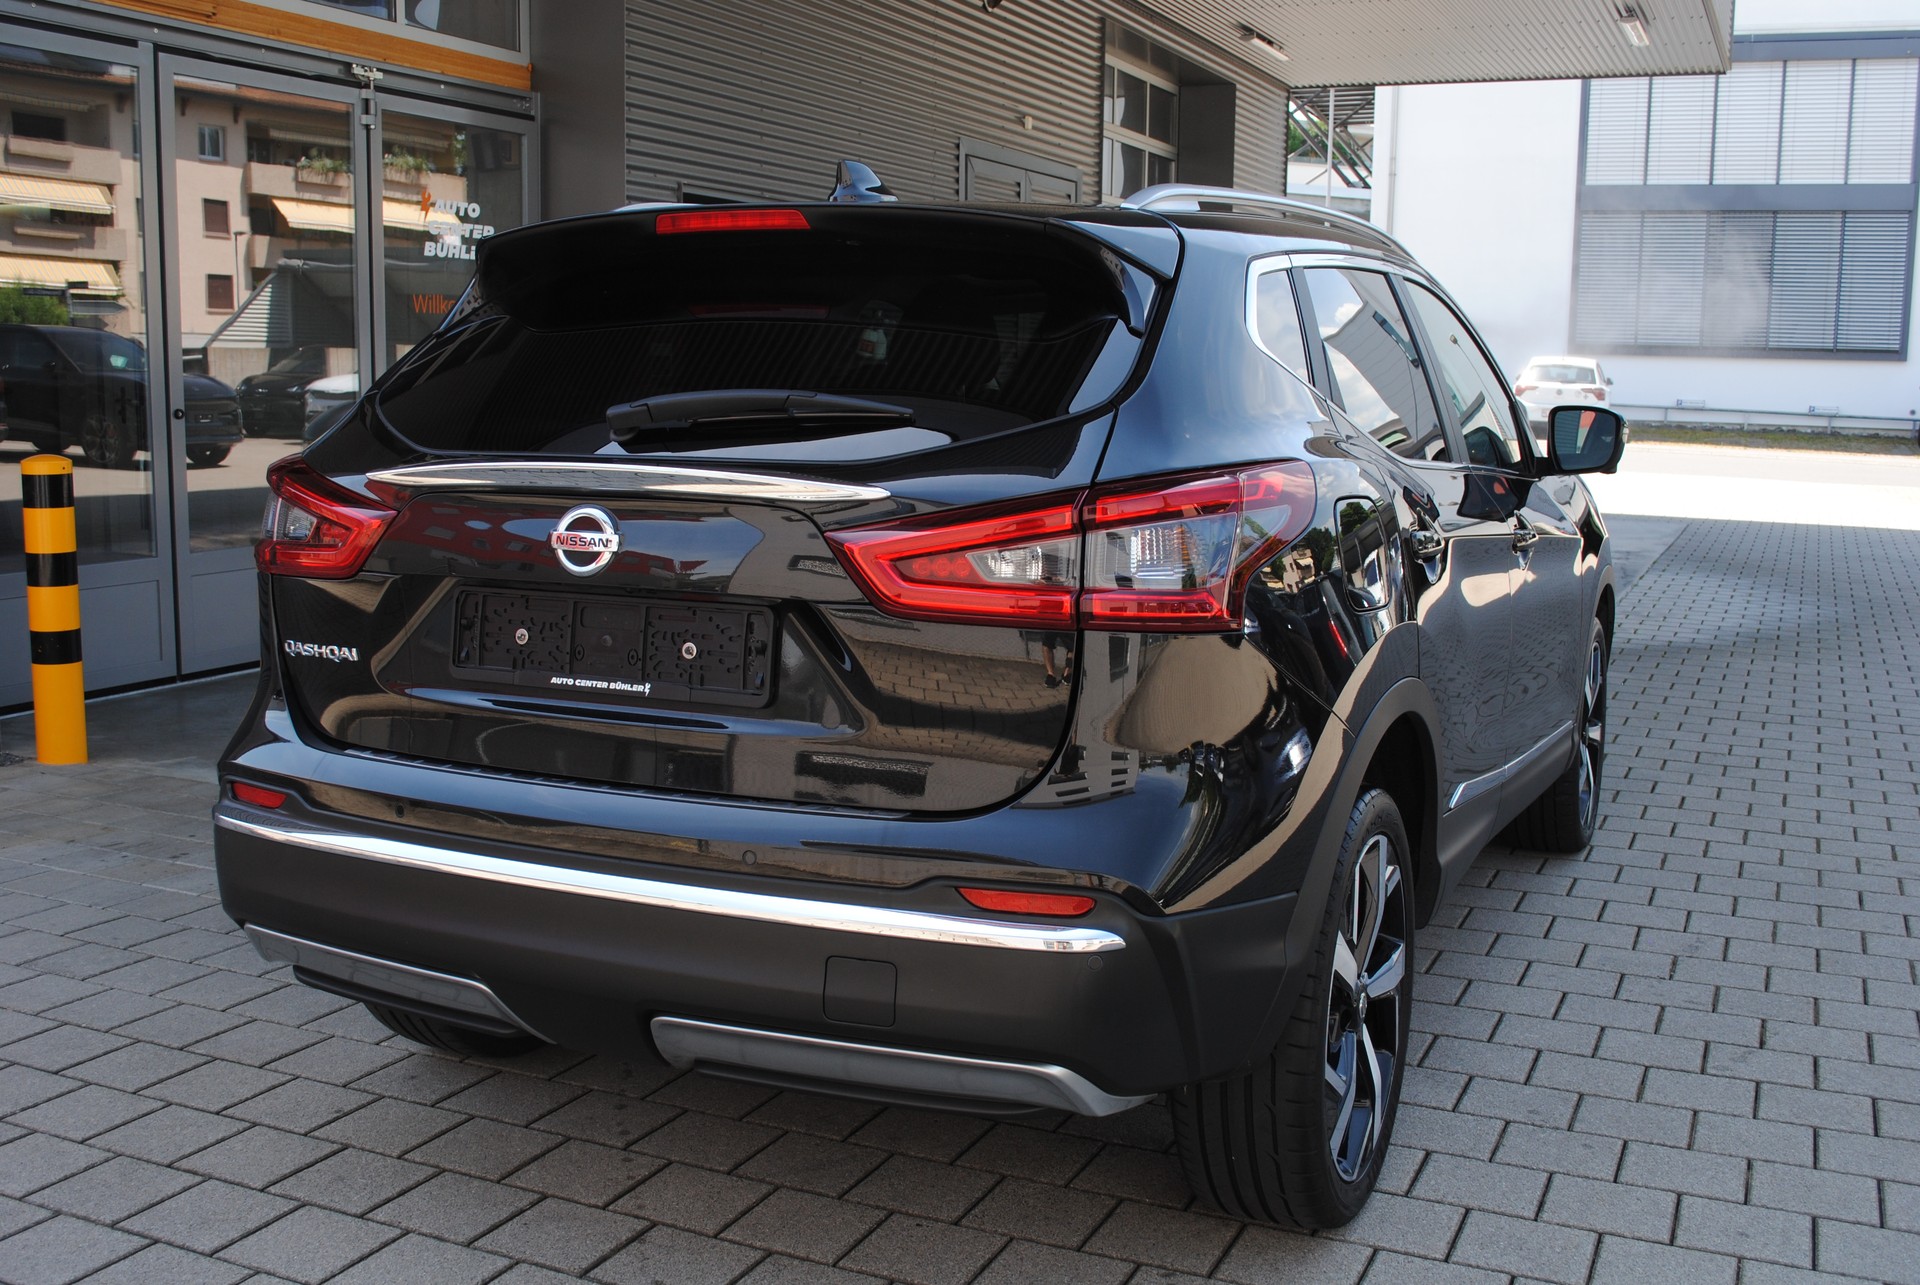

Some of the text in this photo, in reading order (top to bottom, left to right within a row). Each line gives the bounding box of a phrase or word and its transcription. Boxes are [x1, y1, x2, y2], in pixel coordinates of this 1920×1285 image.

[434, 200, 480, 218] AUTO
[556, 535, 609, 548] NISSAN
[284, 640, 359, 663] QASHQAI
[550, 676, 644, 692] AUTO CENTER BÜHLER
